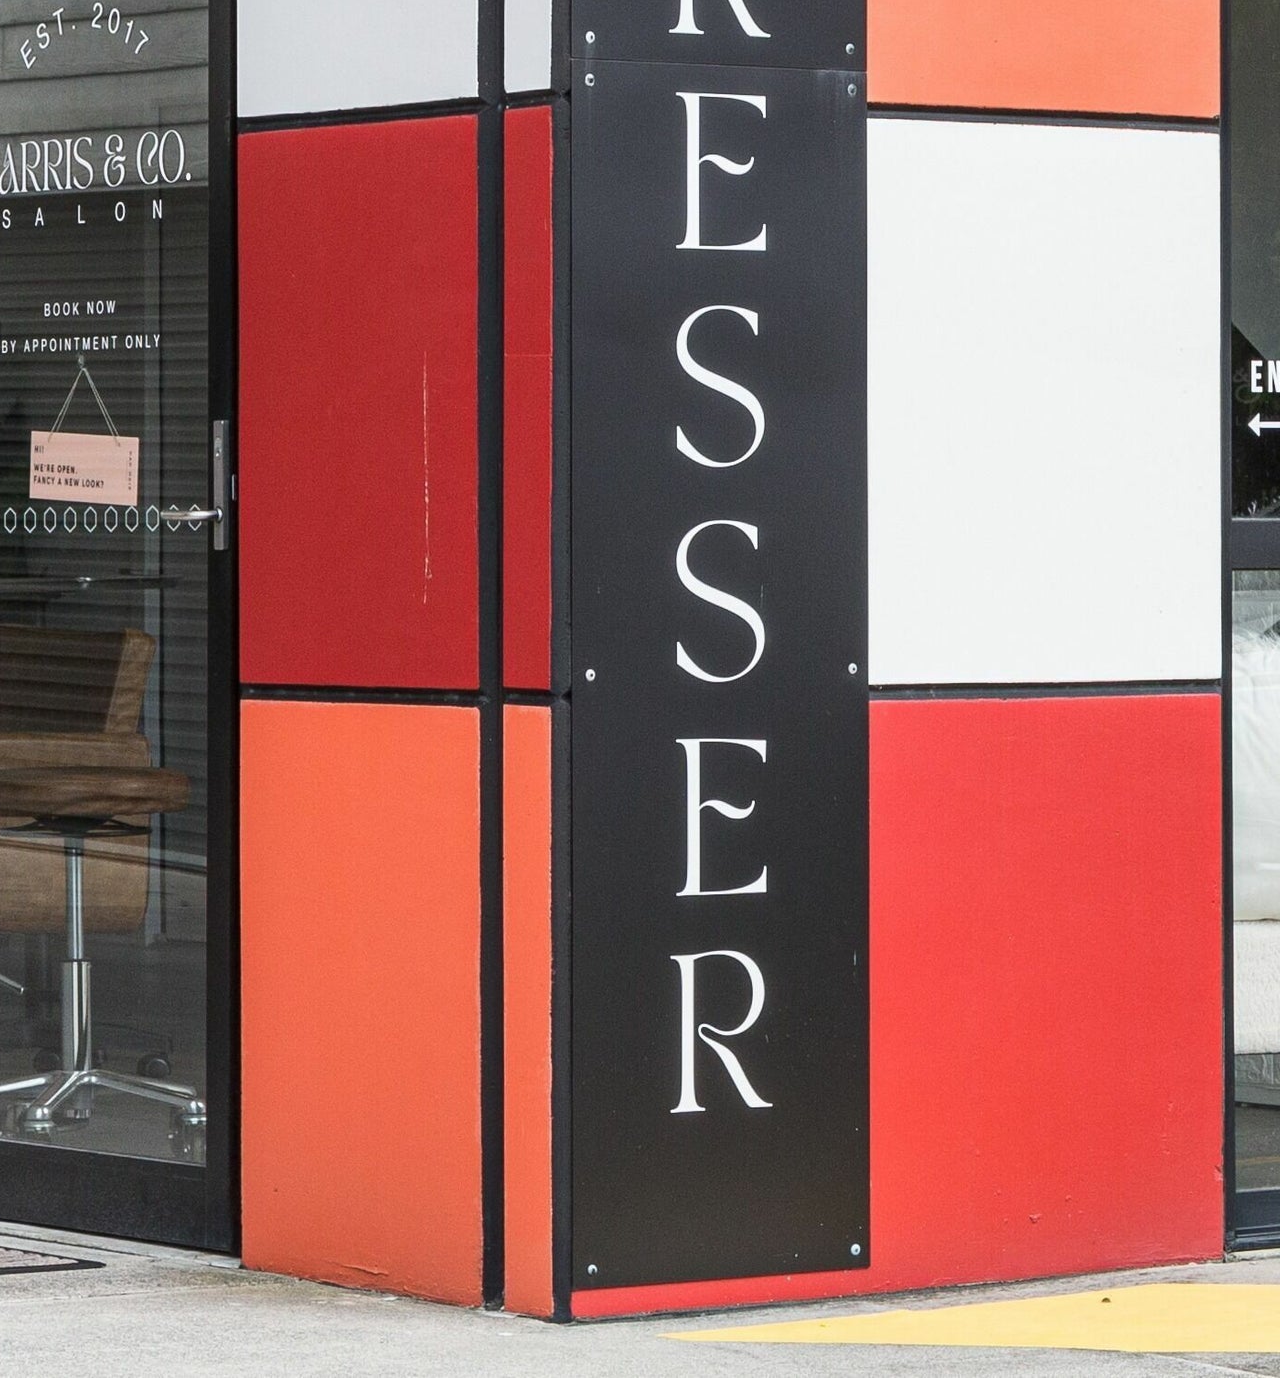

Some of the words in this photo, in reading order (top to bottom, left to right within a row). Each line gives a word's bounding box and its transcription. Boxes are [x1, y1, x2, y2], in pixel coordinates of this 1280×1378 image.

[20, 8, 76, 69] EST.
[91, 2, 149, 55] 2017
[103, 134, 126, 188] &
[136, 129, 191, 185] CO.
[2, 199, 162, 229] SALON
[43, 302, 80, 317] BOOK
[86, 300, 116, 315] NOW
[1, 339, 17, 354] BY
[23, 335, 118, 353] APPOINTMENT
[125, 333, 160, 349] ONLY
[33, 463, 55, 473] WE'RE
[57, 465, 78, 475] OPEN.
[33, 475, 56, 485] FANCY
[57, 477, 62, 486] A
[64, 479, 80, 488] NEW
[81, 479, 104, 489] LOOK?
